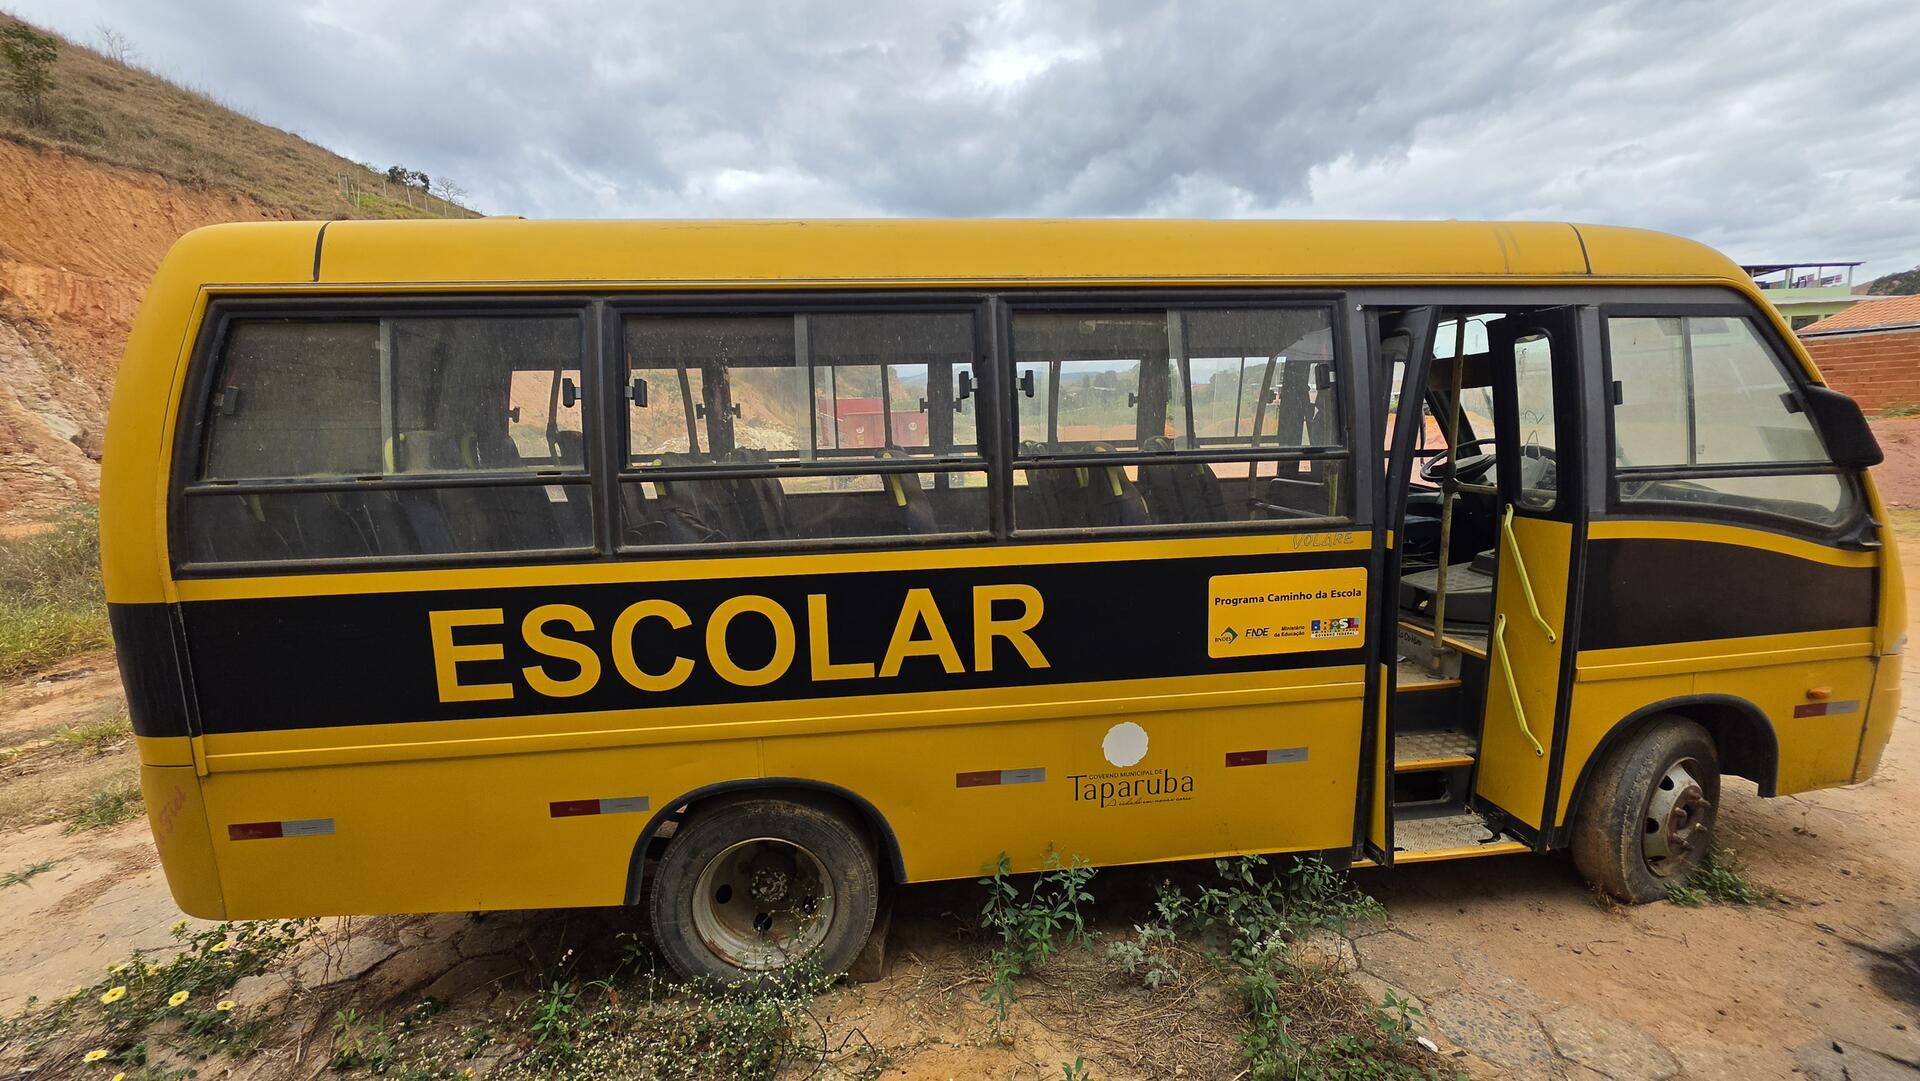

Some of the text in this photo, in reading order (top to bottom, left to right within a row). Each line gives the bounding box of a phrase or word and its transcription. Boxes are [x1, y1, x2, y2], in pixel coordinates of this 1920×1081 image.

[1292, 532, 1354, 549] VOLARE
[1214, 588, 1362, 607] Programa Caminho da Escola
[1245, 627, 1270, 638] FNDE
[428, 583, 1051, 703] ESCOLAR
[1120, 769, 1153, 777] MUNICIPAL
[1066, 769, 1194, 808] Taparuba
